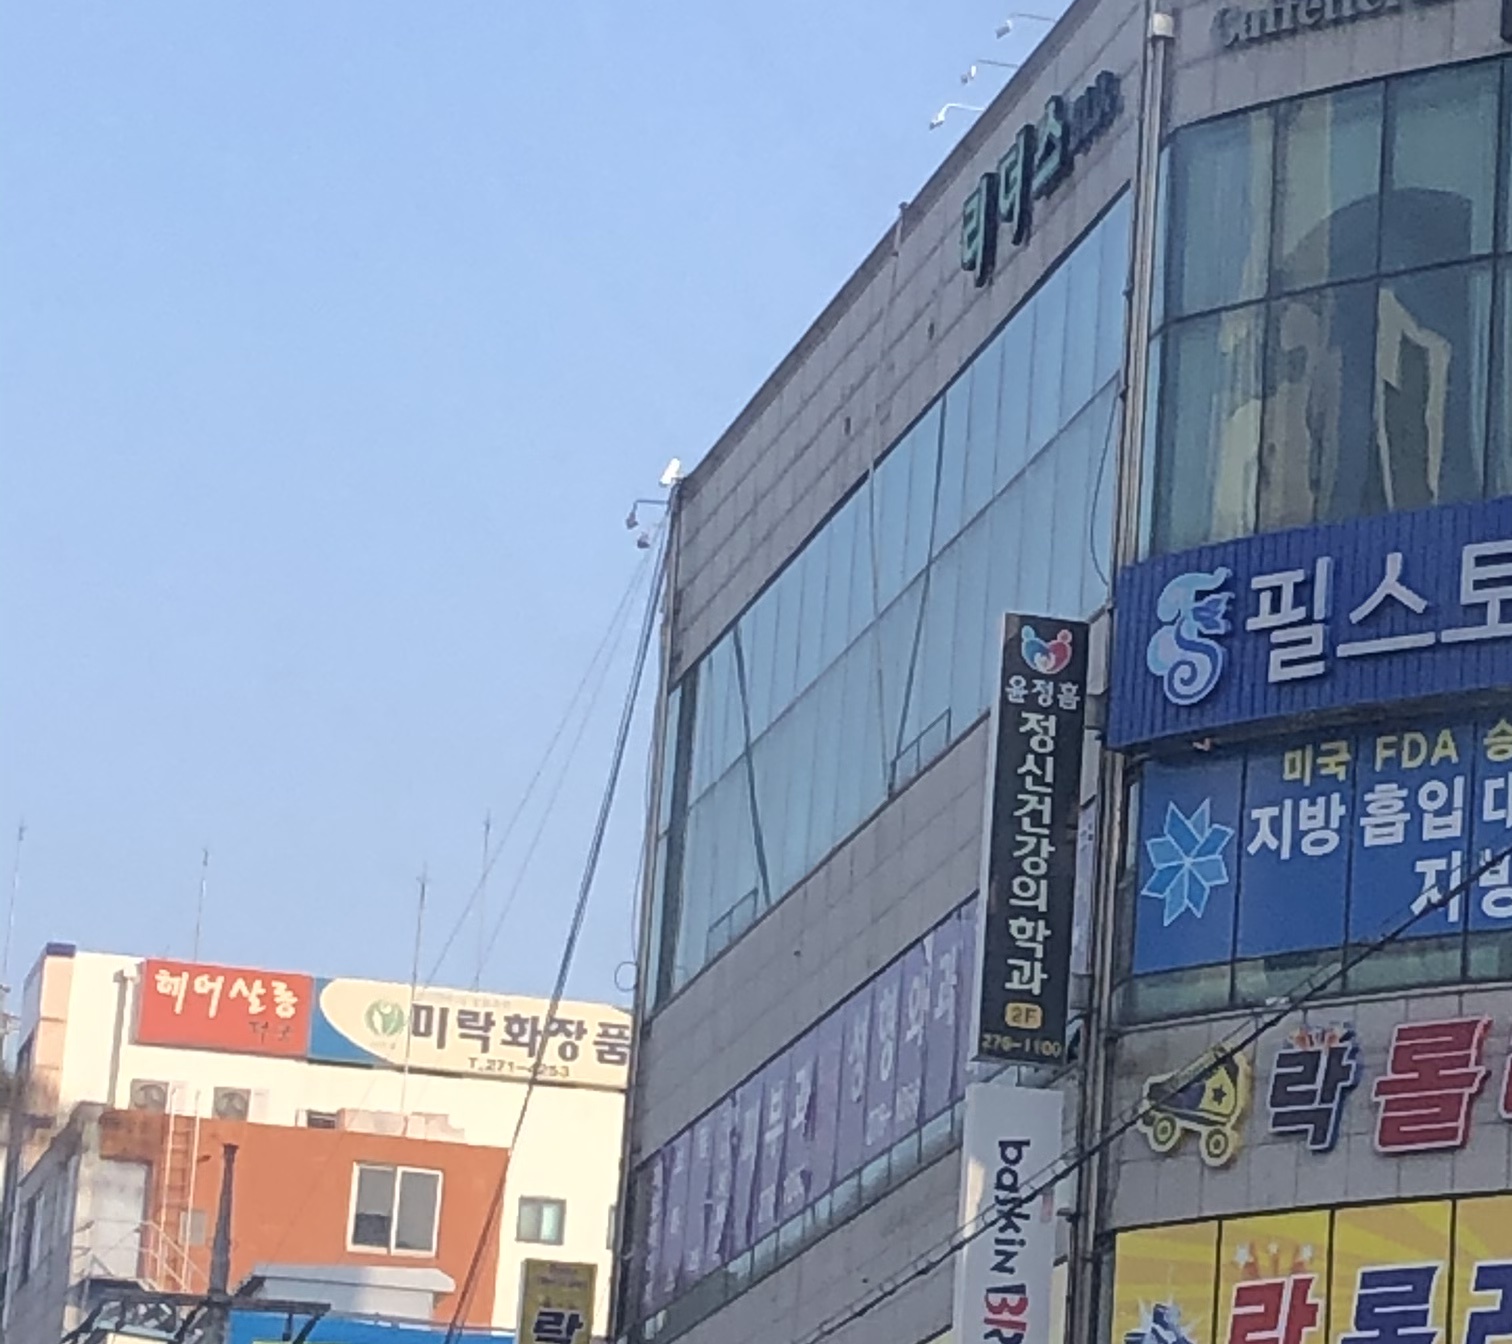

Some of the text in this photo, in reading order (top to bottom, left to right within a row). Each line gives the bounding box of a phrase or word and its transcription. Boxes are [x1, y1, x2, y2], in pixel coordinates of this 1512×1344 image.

[1282, 739, 1354, 787] 미국
[1374, 728, 1460, 773] FDA
[1004, 711, 1058, 996] 정신건강의학과
[411, 1002, 633, 1066] 미락화장품
